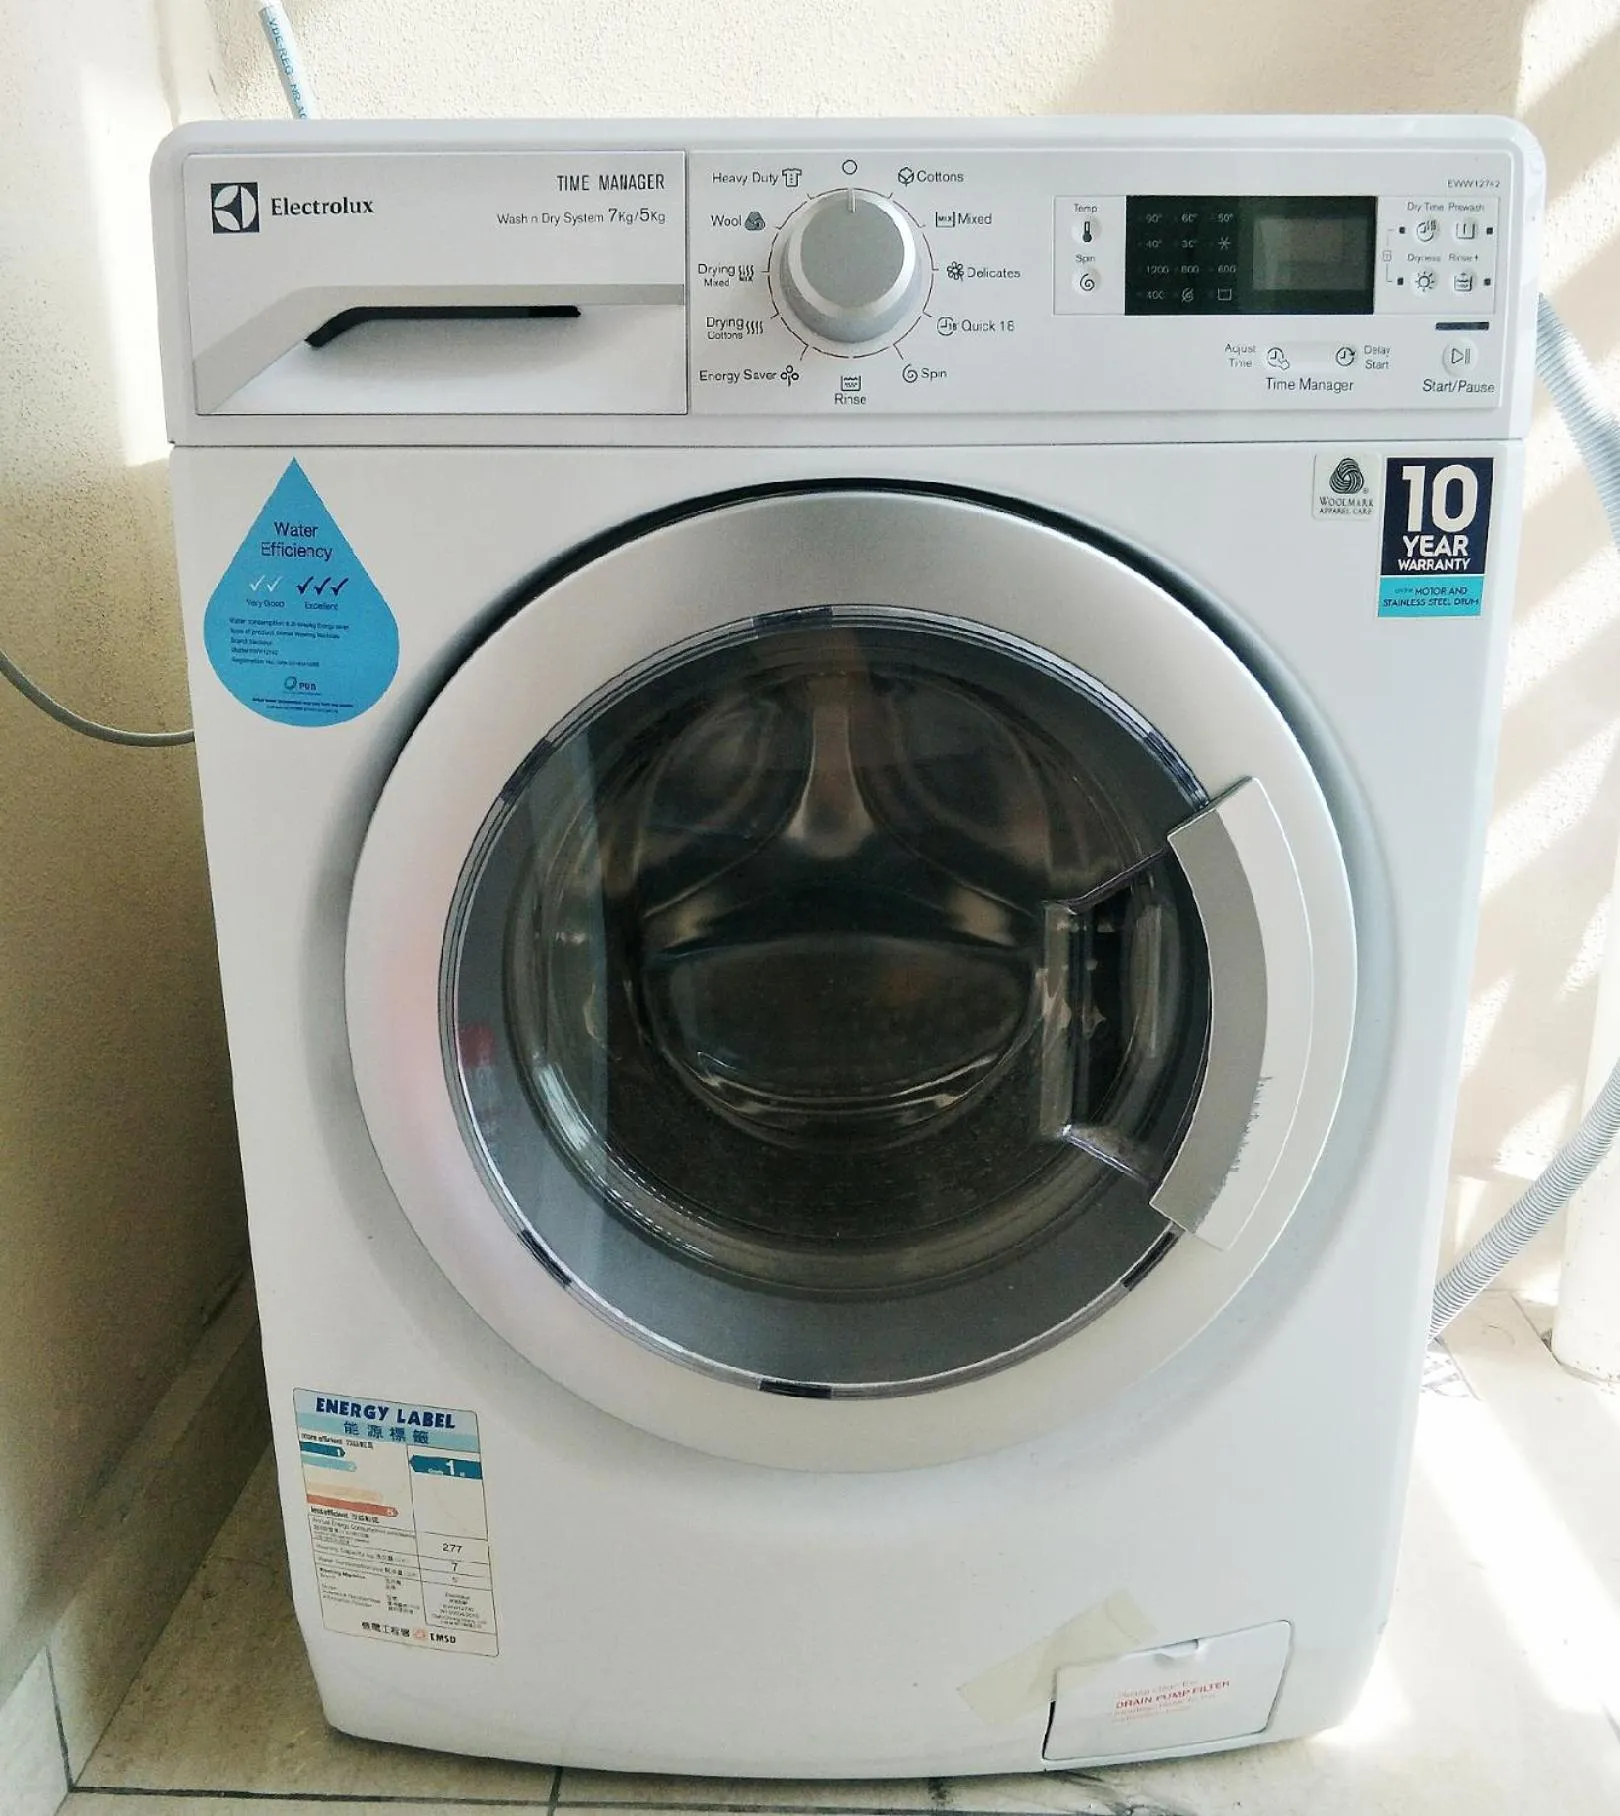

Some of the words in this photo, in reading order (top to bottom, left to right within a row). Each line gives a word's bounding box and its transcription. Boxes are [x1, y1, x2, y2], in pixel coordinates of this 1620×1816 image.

[557, 175, 590, 191] TIME
[598, 174, 665, 191] MANAGER
[712, 172, 748, 186] Heavy
[752, 171, 779, 186] Duty
[917, 170, 964, 183] Cottons
[271, 196, 374, 216] Electrolux
[1073, 204, 1098, 214] Temp
[1406, 202, 1423, 214] Dry
[1424, 202, 1445, 212] Time
[497, 212, 528, 225] Wash
[541, 211, 561, 227] Dry
[563, 211, 605, 226] System
[608, 208, 666, 226] 7Kg/5Kg
[711, 214, 743, 227] Wool
[957, 213, 993, 225] Mixed
[1075, 254, 1096, 265] Spin
[698, 263, 736, 278] Drying
[967, 266, 1021, 279] Delicates
[704, 278, 730, 287] Mixed
[706, 317, 744, 331] Drying
[961, 319, 995, 333] Quick
[707, 331, 743, 341] Cottons
[1224, 343, 1257, 356] Adjust
[1363, 345, 1391, 358] Delay
[1228, 358, 1254, 369] Time
[1365, 359, 1390, 370] Start
[699, 369, 741, 384] Energy
[743, 369, 777, 381] Saver
[921, 368, 948, 381] Spin
[1266, 377, 1296, 392] Time
[1299, 378, 1354, 394] Manager
[1422, 379, 1496, 394] Start/Pause
[834, 393, 867, 405] Rinse
[1319, 496, 1374, 508] WOOLMARK
[1402, 464, 1478, 533] 10
[274, 521, 319, 538] Water
[261, 541, 334, 562] Efficiency
[1402, 535, 1469, 557] YEAR
[1397, 558, 1472, 572] WARRANTY
[1414, 587, 1447, 595] MOTOR
[1448, 586, 1468, 595] AND
[304, 601, 339, 611] Excellent
[1383, 598, 1427, 608] STAINLESS
[1428, 598, 1452, 606] STEEL
[1453, 597, 1480, 606] DRUM
[315, 1397, 390, 1421] ENERGY
[396, 1408, 456, 1429] LABEL
[445, 1459, 455, 1476] 1
[442, 1543, 463, 1554] 277
[451, 1562, 459, 1572] 7
[430, 1632, 457, 1644] EMSD
[1116, 1695, 1153, 1709] DRAIN
[1155, 1689, 1191, 1702] PUMP
[1191, 1679, 1231, 1694] FILTER
